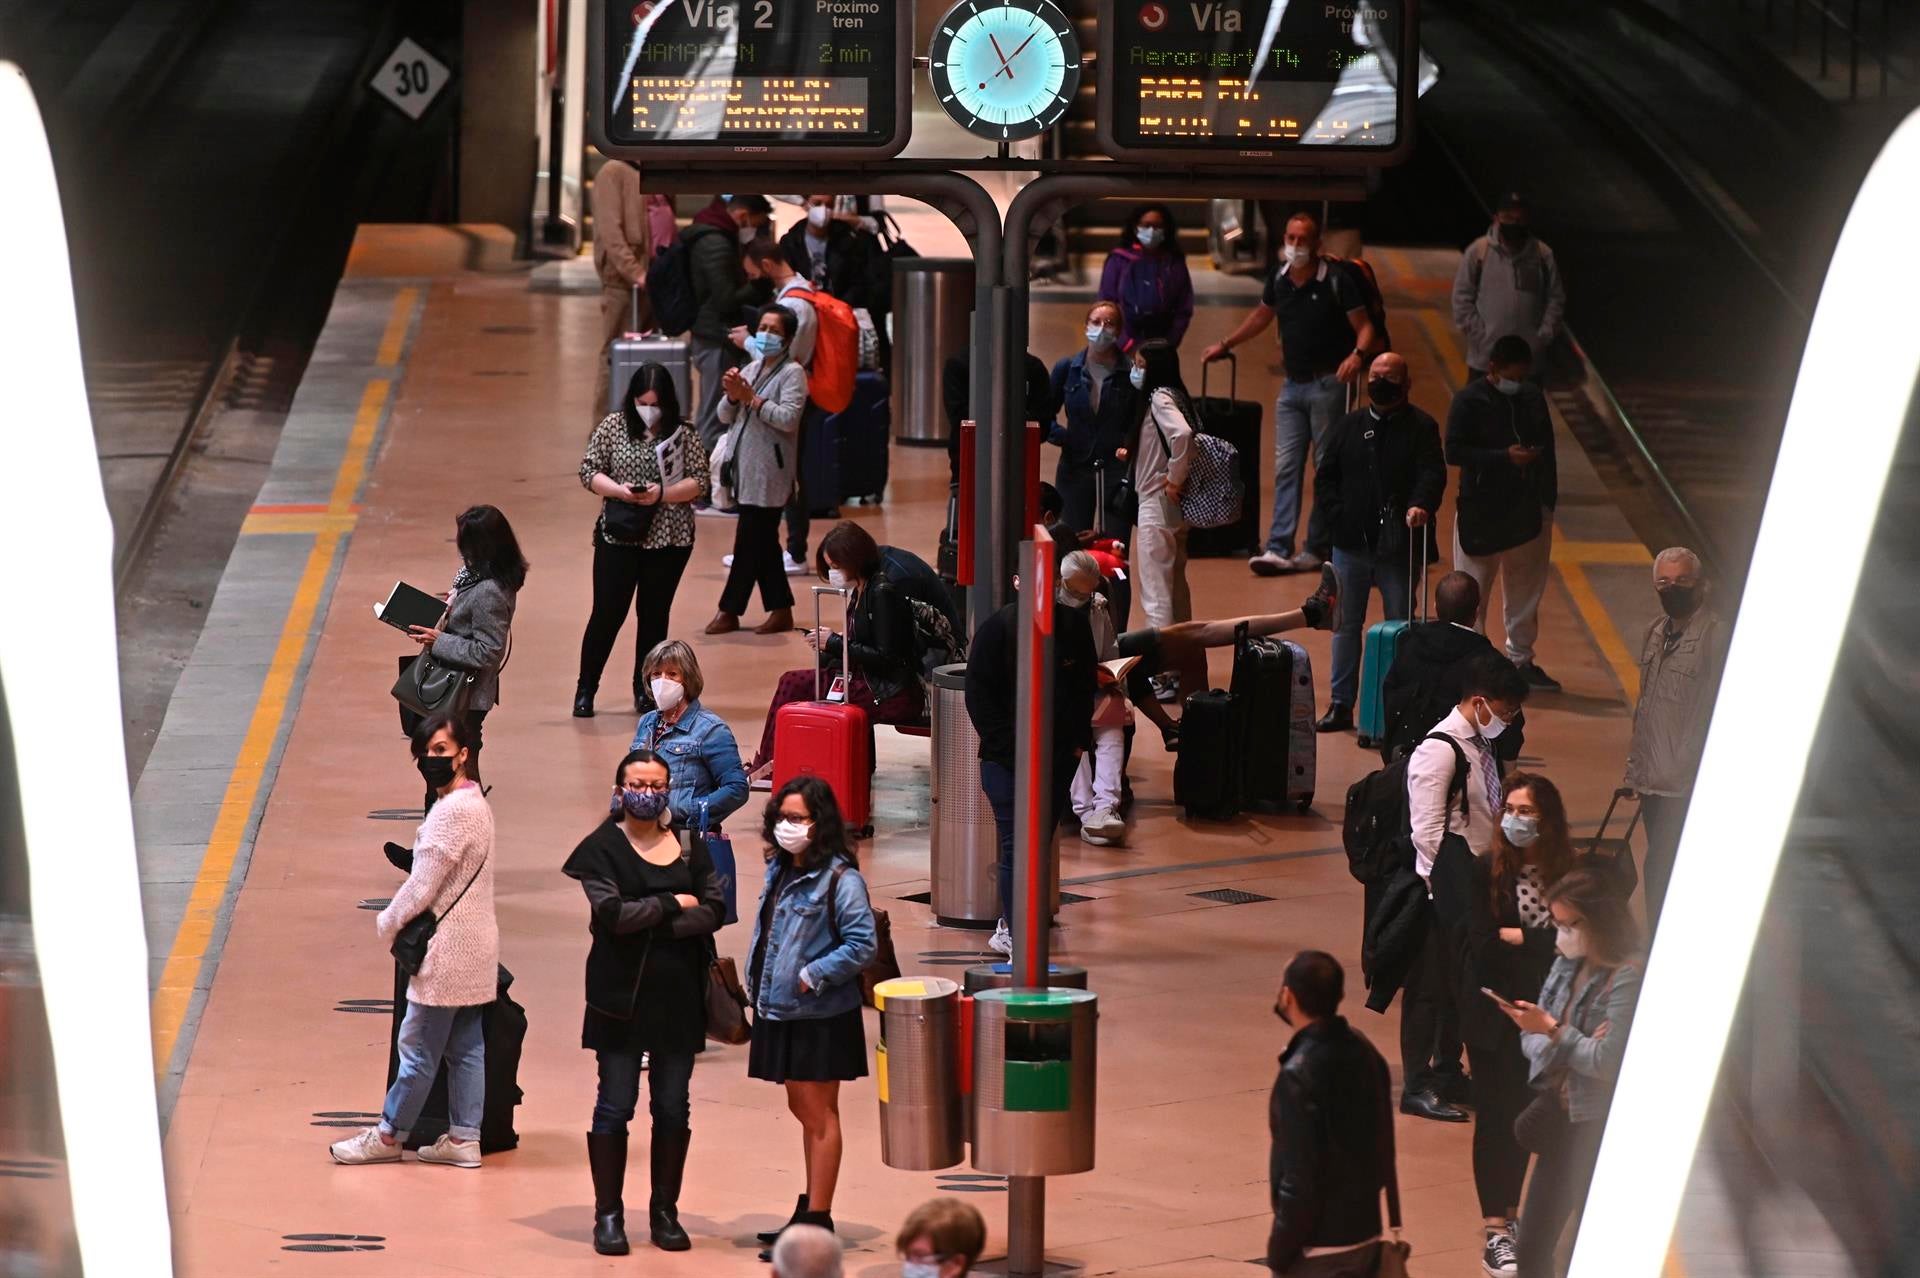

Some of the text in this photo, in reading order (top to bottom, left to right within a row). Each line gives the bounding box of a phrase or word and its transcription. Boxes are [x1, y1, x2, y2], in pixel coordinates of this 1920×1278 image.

[683, 0, 773, 30] Vía 2
[817, 0, 879, 14] Próximo
[1190, 2, 1242, 32] Vía
[833, 15, 863, 28] tren
[819, 43, 872, 63] 2 min
[1130, 46, 1301, 69] Aeropuert T4
[395, 60, 428, 97] 30
